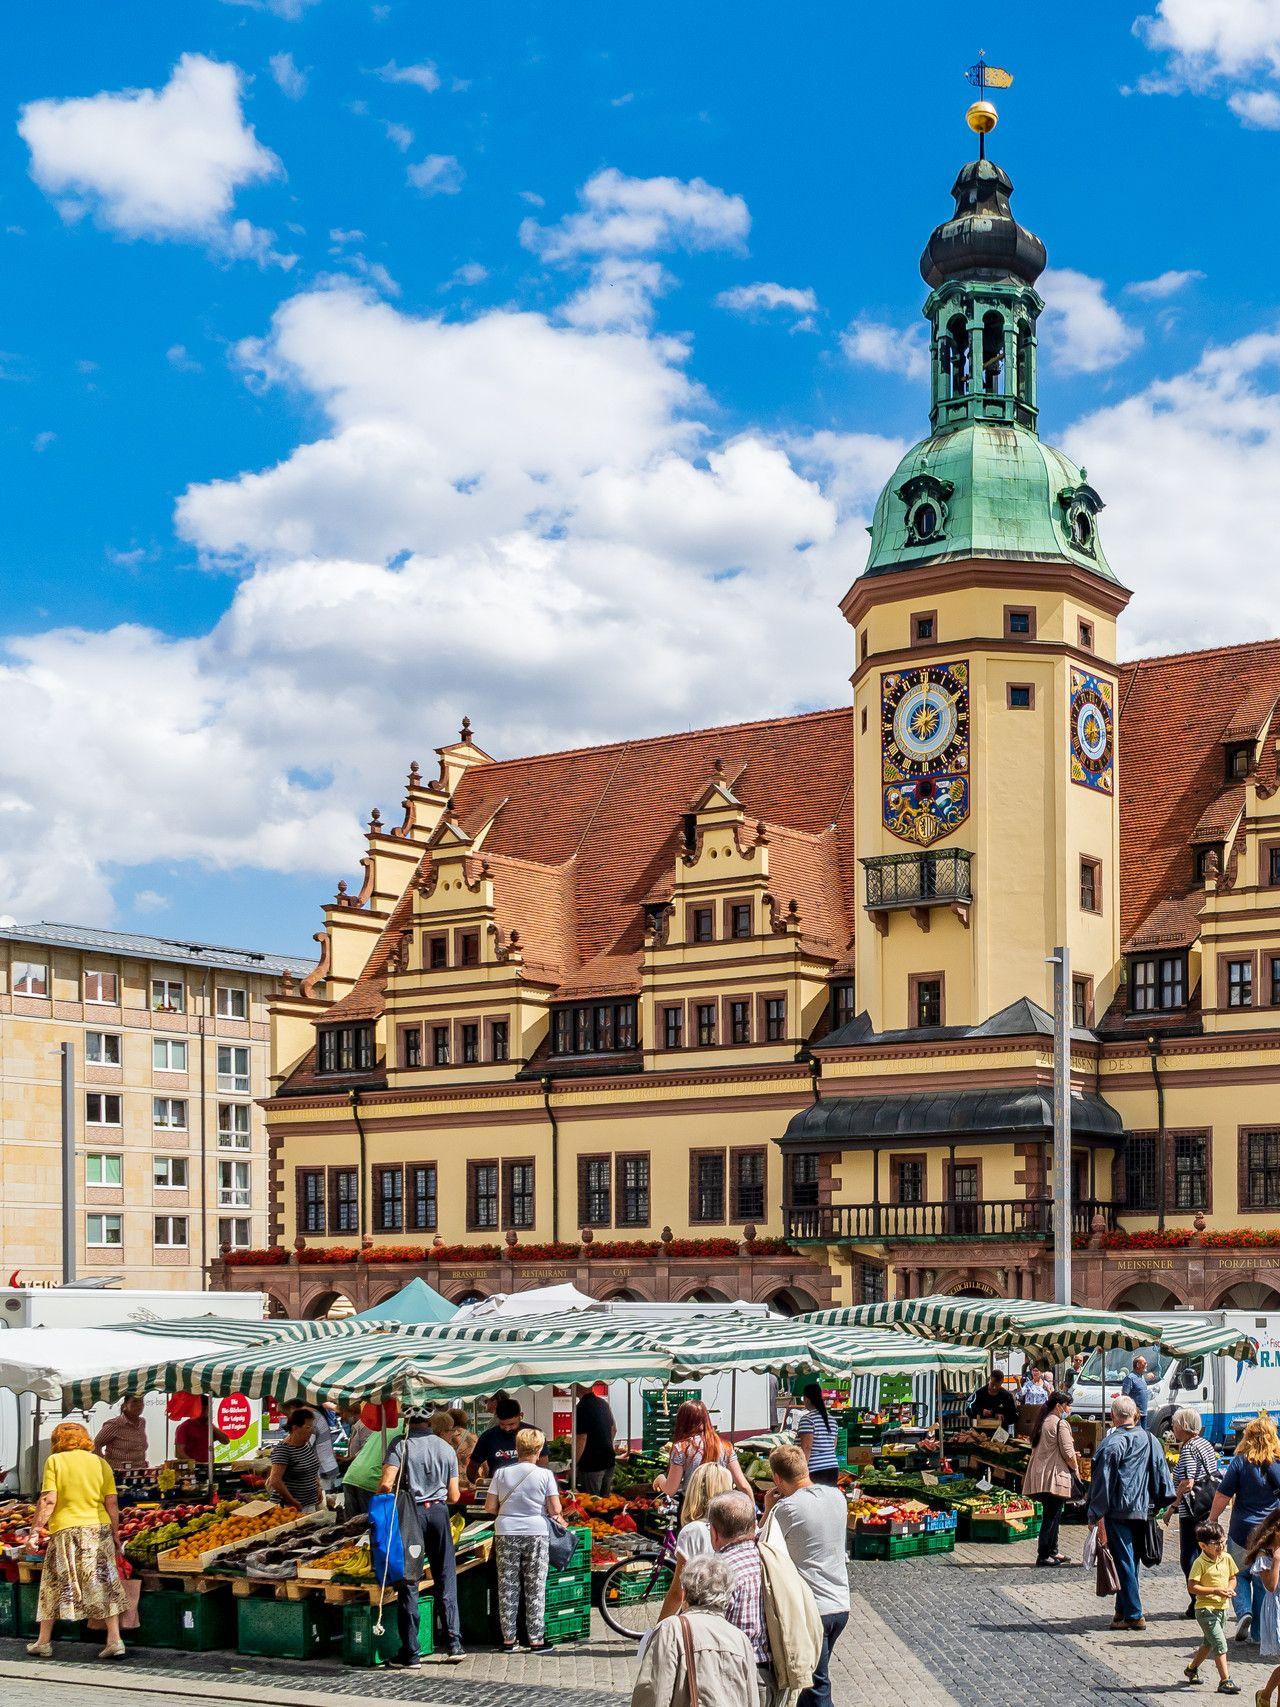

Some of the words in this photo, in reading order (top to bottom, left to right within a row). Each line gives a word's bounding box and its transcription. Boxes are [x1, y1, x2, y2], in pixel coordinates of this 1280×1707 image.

[1108, 1059, 1133, 1072] DES
[1117, 1259, 1174, 1269] MEISSENER
[1218, 1258, 1280, 1269] PORZELLAN
[452, 1270, 488, 1279] BRASSERIE
[521, 1269, 568, 1278] RESTAURANT
